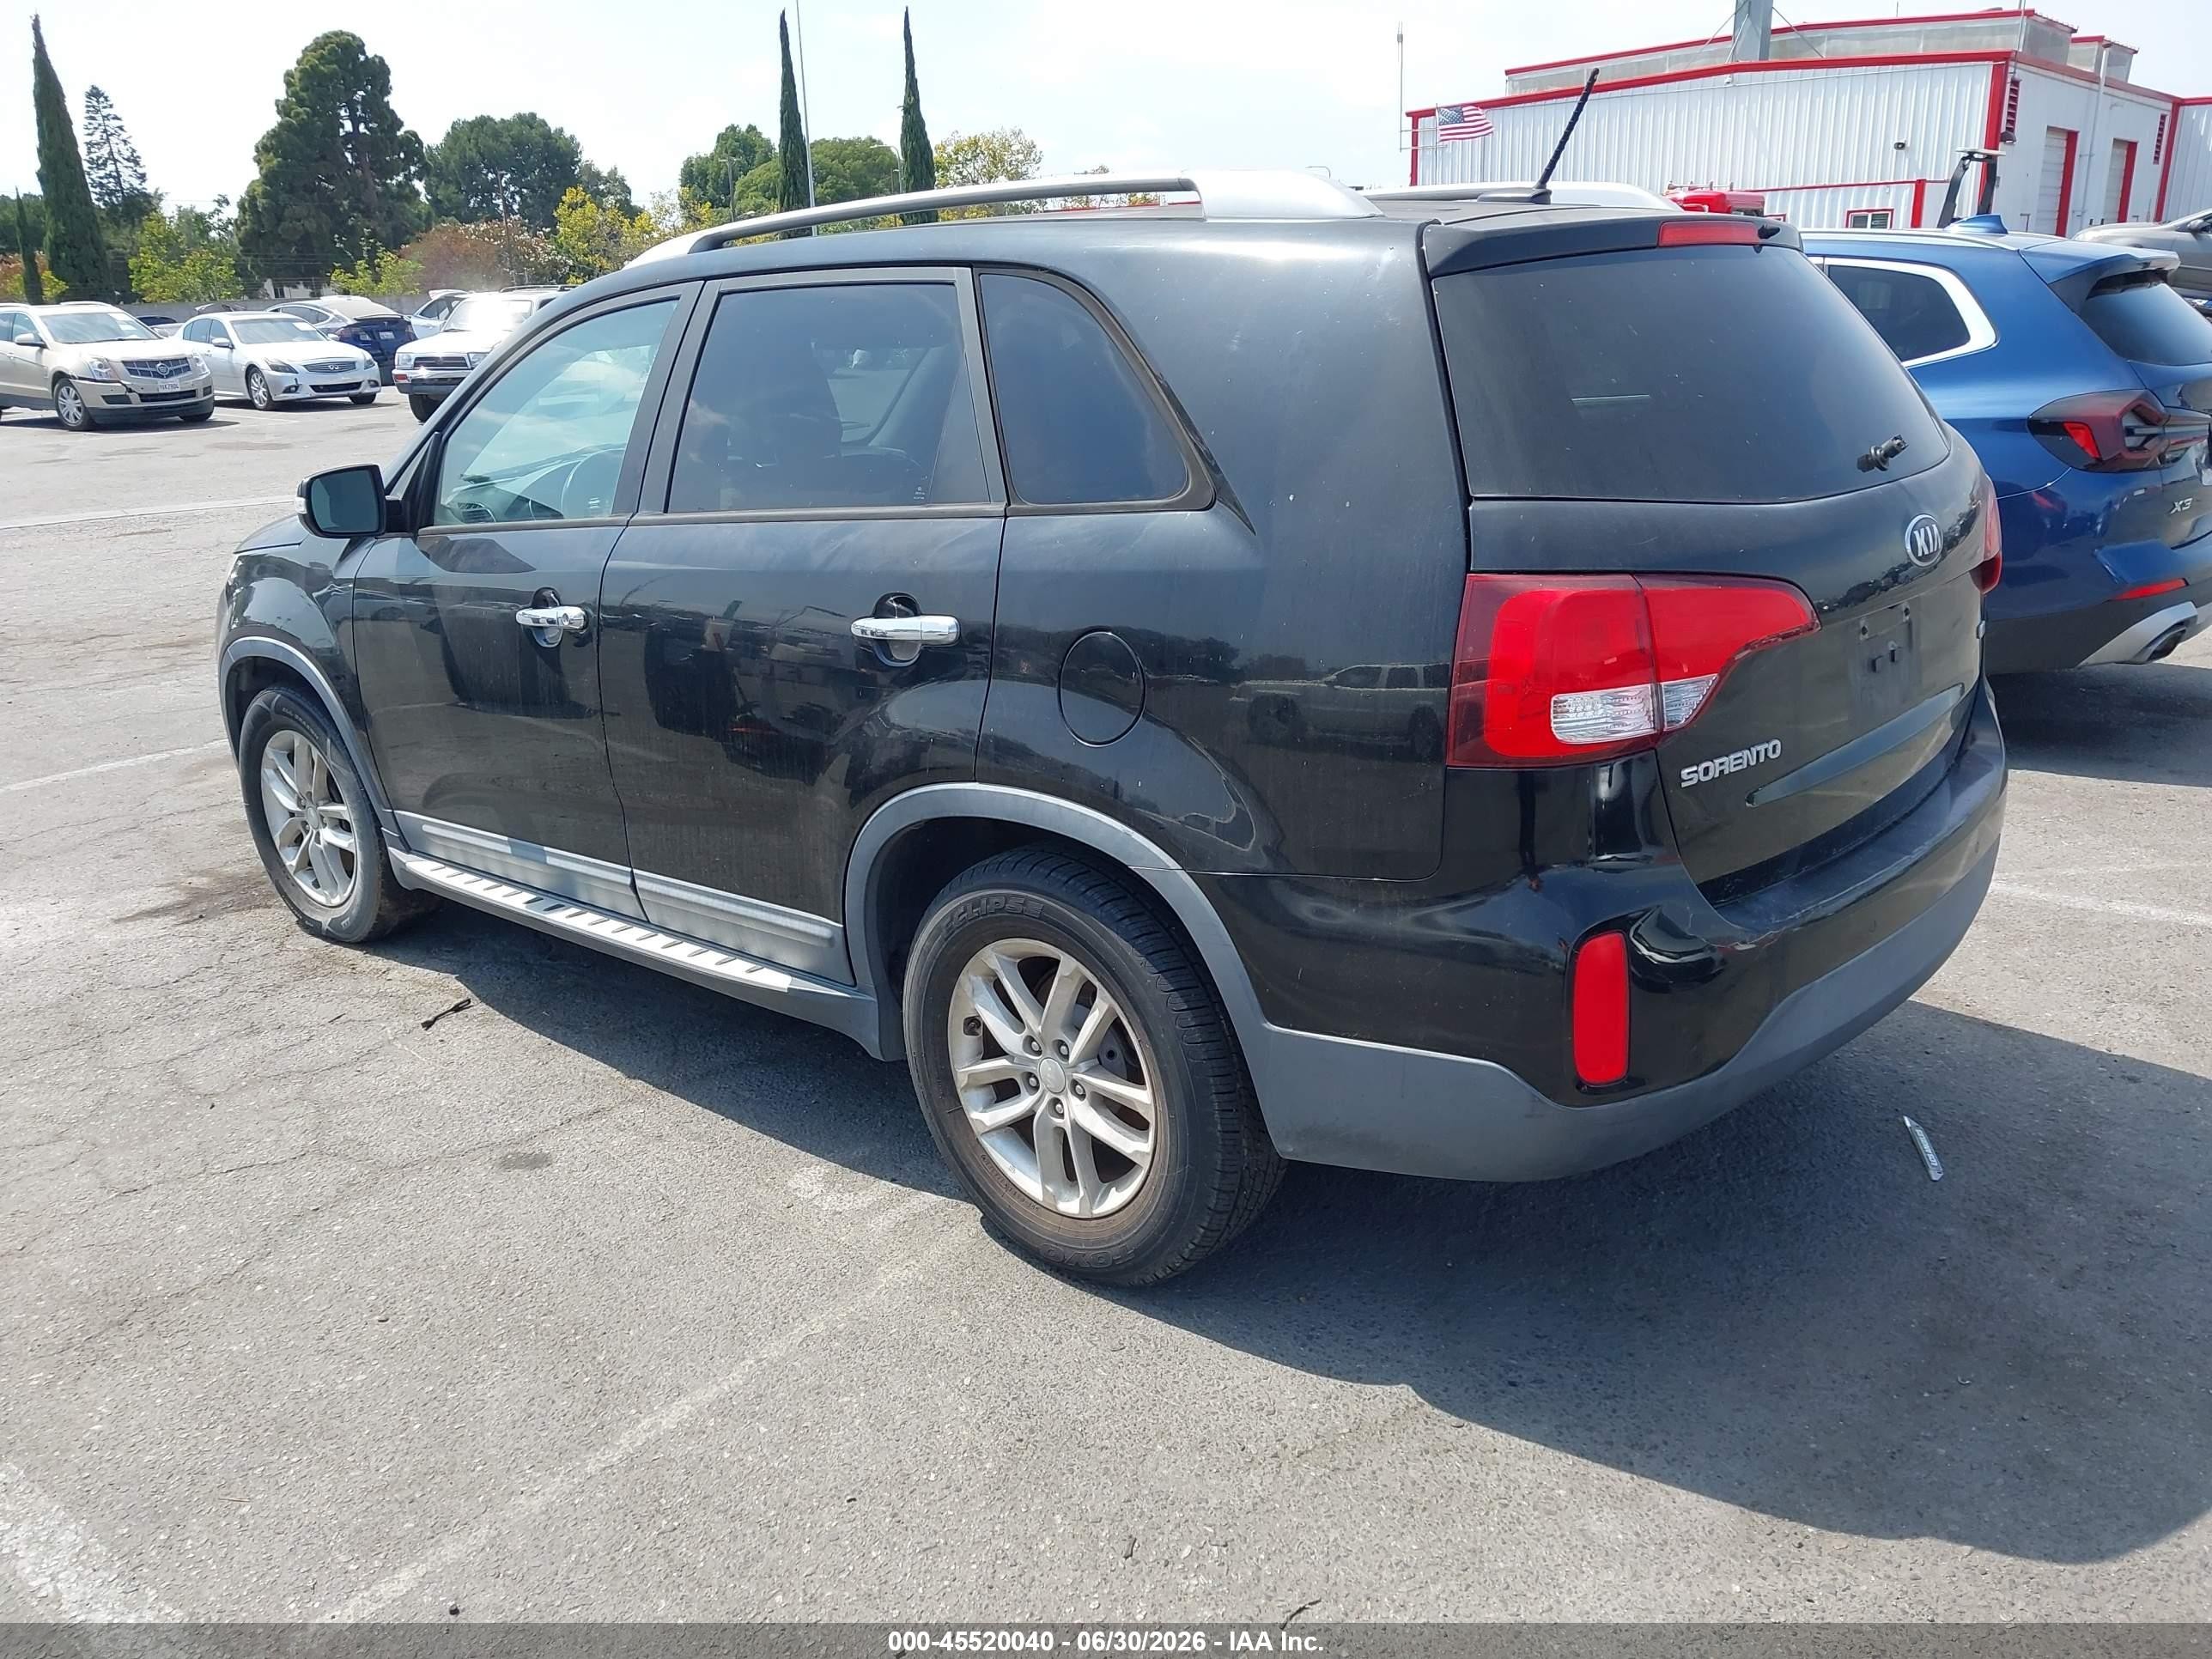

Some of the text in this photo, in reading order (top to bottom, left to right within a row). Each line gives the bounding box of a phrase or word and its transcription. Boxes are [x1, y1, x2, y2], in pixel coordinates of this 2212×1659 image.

[2170, 498, 2193, 514] X3
[1914, 525, 1942, 556] KIA
[1680, 738, 1782, 788] SORENTO
[942, 896, 1045, 933] ECLIPSE
[1042, 1241, 1135, 1268] TOYO
